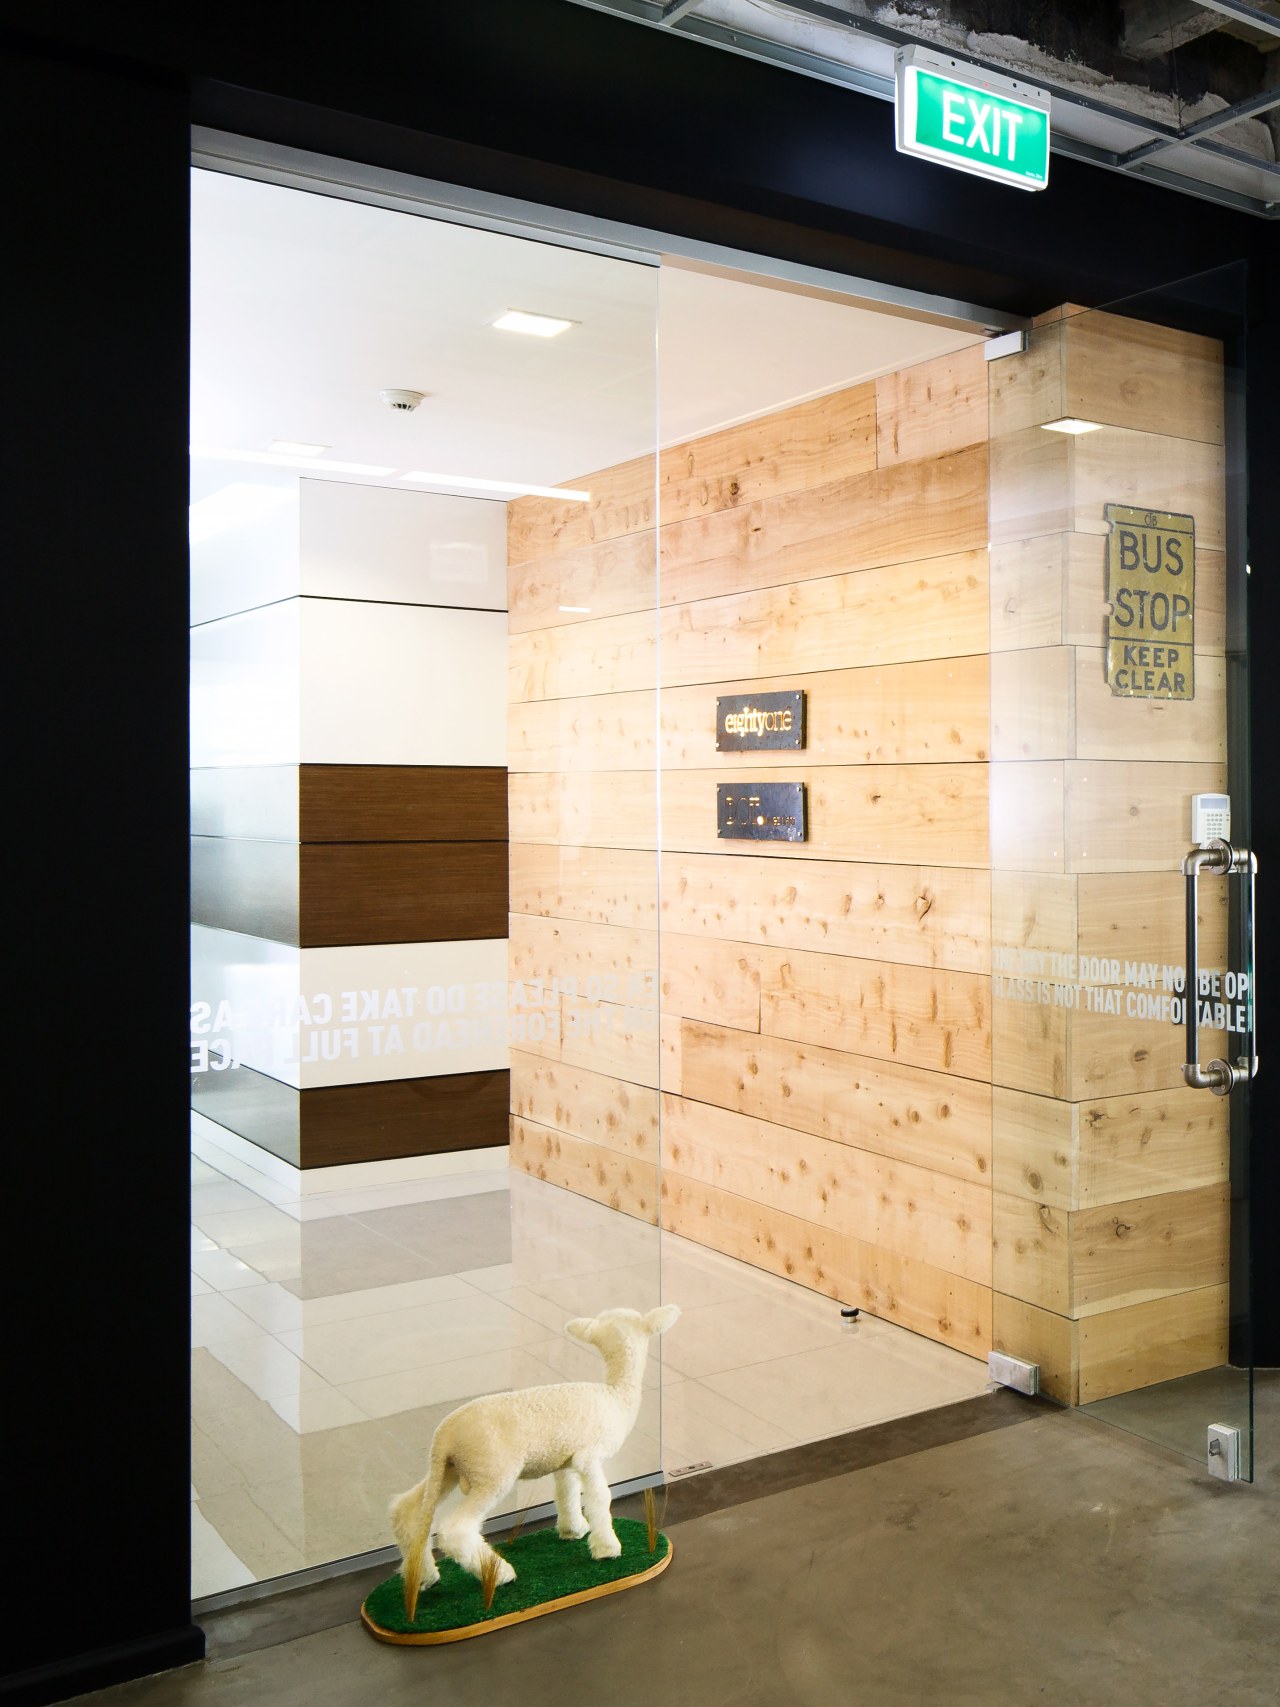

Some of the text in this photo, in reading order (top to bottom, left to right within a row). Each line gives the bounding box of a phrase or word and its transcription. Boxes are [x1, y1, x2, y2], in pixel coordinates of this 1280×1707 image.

[942, 89, 1023, 162] EXIT
[1119, 530, 1184, 576] BUS
[1115, 588, 1190, 632] STOP
[1123, 645, 1179, 668] KEEP
[1115, 669, 1185, 692] CLEAR
[1049, 952, 1076, 979] THE
[1080, 955, 1120, 985] DOOR
[1124, 960, 1158, 990] MAY
[1162, 965, 1187, 993] NO
[1199, 968, 1221, 998] BE
[1037, 980, 1050, 1005] IS
[1054, 983, 1081, 1009] NOT
[1085, 985, 1123, 1015] THAT
